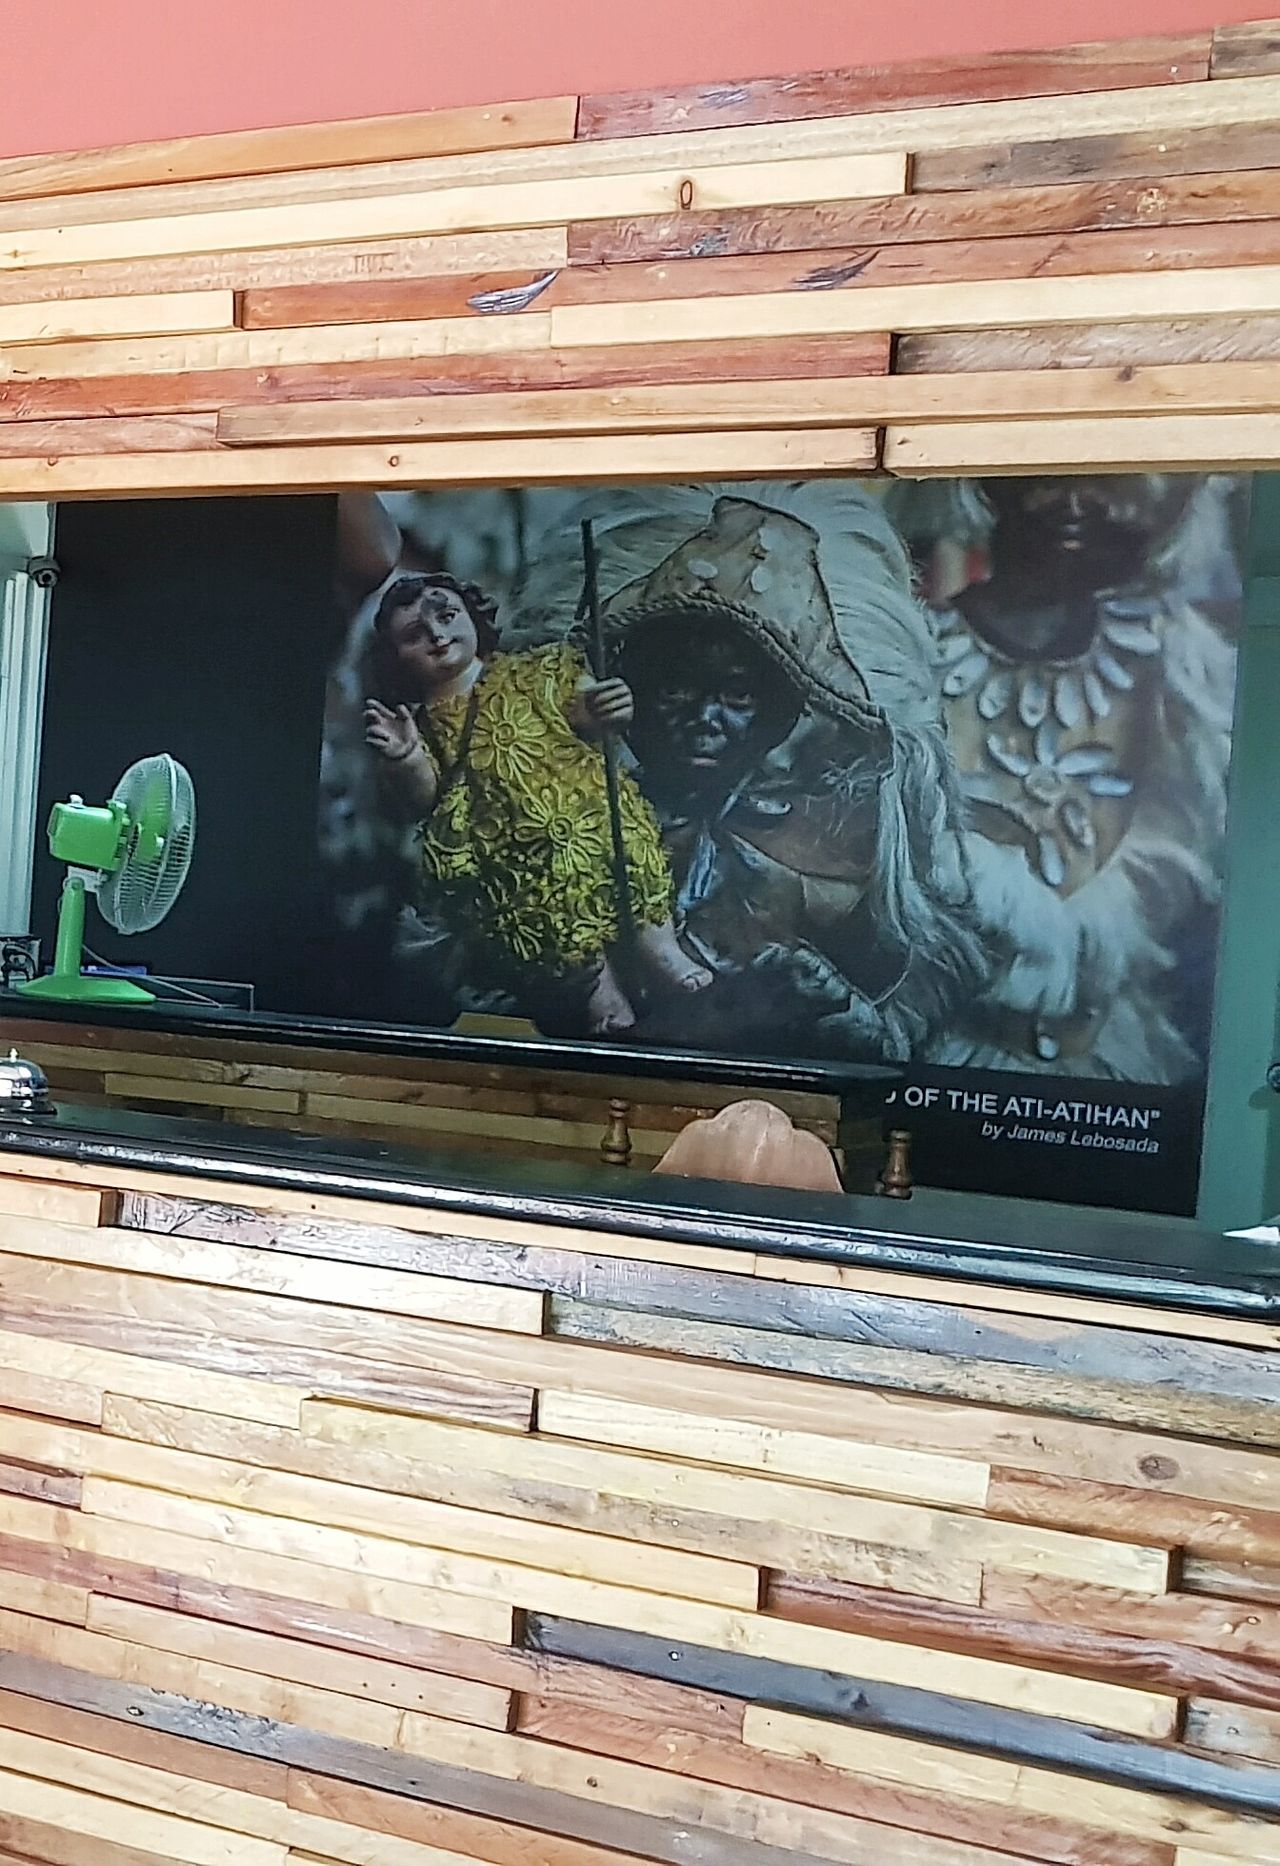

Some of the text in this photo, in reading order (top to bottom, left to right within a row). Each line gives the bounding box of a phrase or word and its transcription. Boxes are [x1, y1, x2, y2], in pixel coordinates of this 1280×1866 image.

[904, 1086, 940, 1108] OF
[946, 1089, 998, 1114] THE
[1002, 1096, 1161, 1130] ATI-ATIHAN"
[981, 1120, 1004, 1140] by
[1007, 1124, 1066, 1145] James
